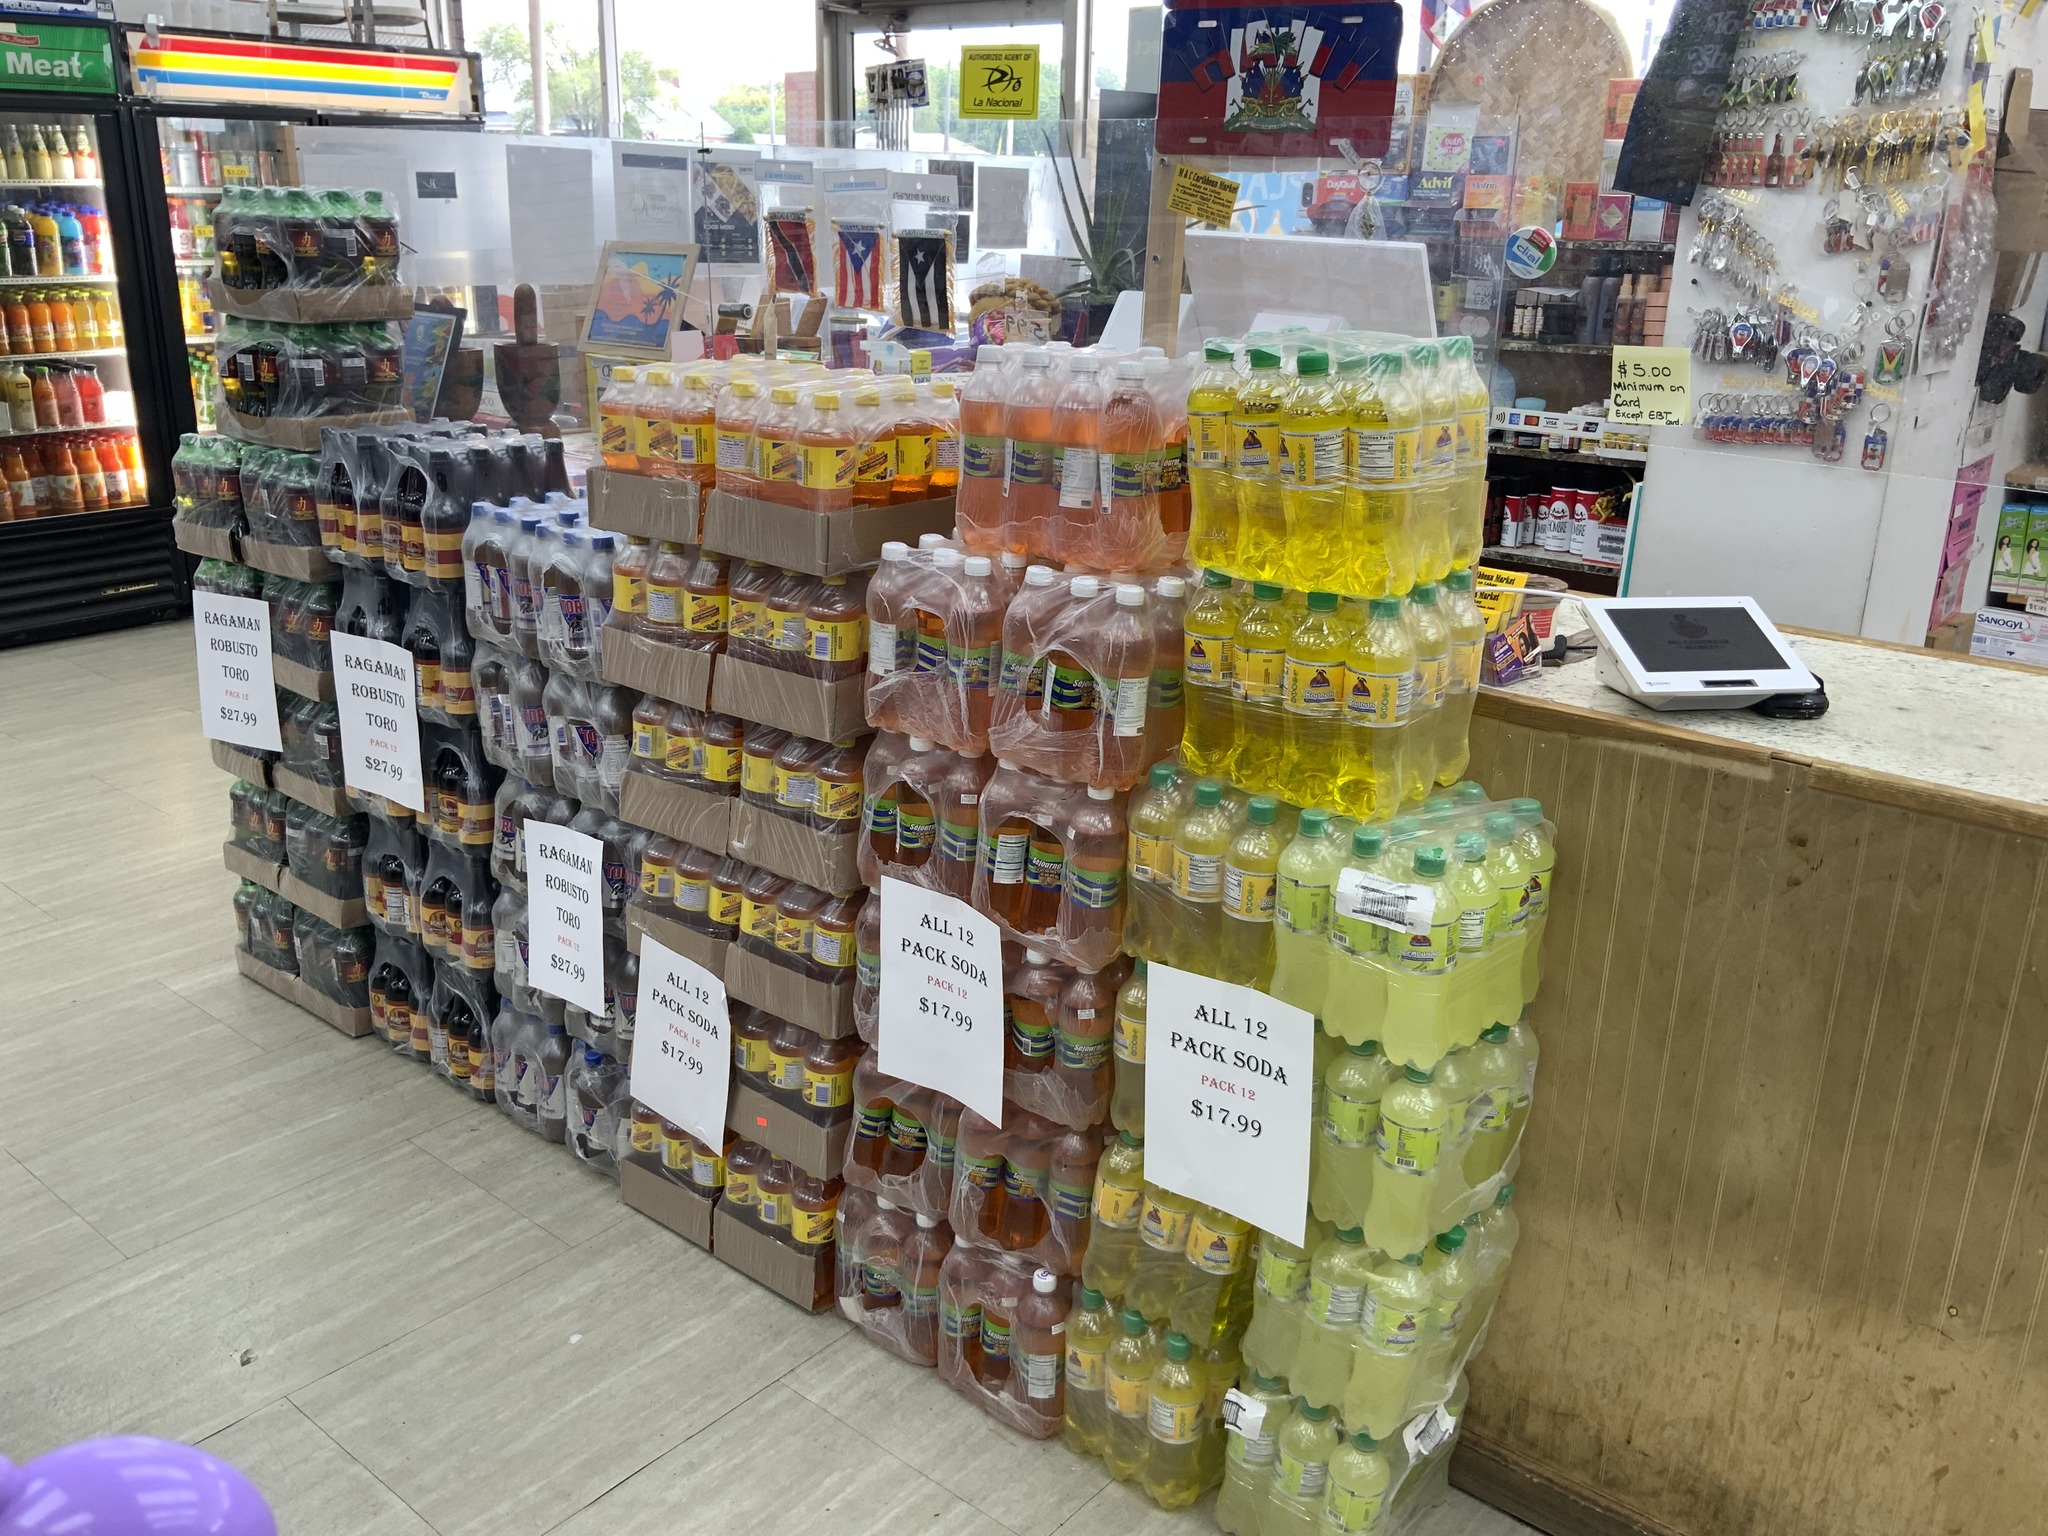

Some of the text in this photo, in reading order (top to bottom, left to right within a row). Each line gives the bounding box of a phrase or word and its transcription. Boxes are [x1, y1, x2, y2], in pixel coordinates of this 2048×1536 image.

[968, 53, 1032, 61] AUTHORIZED AGENT OF
[1178, 8, 1381, 93] HAITI
[5, 51, 82, 78] Meat
[973, 97, 1024, 108] La Nacional
[1418, 176, 1453, 189] Advil
[1471, 180, 1499, 189] Motrin
[1516, 243, 1541, 266] dial
[1613, 381, 1685, 394] Minimum on
[1614, 393, 1640, 408] Card
[1616, 409, 1672, 421] Except EBT
[1549, 521, 1568, 535] OMBRE
[1495, 574, 1516, 586] Market
[560, 600, 582, 614] TOR
[1480, 592, 1500, 602] Market
[204, 610, 261, 632] RAGAMAN
[1977, 613, 2024, 630] SANOGYL
[210, 637, 258, 658] ROBUSTO
[221, 665, 250, 682] TORO
[344, 653, 407, 682] RAGAMAN
[225, 689, 250, 701] PACK 12
[351, 682, 406, 709] ROBUSTO
[220, 706, 257, 727] $27.99
[365, 712, 398, 733] TORO
[521, 708, 545, 722] TOR
[370, 738, 398, 753] PACK 12
[365, 755, 403, 782] $27.99
[539, 843, 593, 876] RAGAMAN
[545, 874, 589, 904] ROBUSTO
[556, 906, 581, 930] TORO
[919, 913, 975, 947] ALL 12
[557, 934, 580, 952] PACK 12
[550, 953, 585, 983] $27.99
[900, 937, 988, 988] PACK SODA
[666, 971, 710, 1005] ALL 12
[927, 974, 968, 1000] PACK 12
[651, 987, 719, 1041] PACK SODA
[919, 996, 973, 1033] $17.99
[1194, 1004, 1268, 1040] ALL 12
[668, 1022, 701, 1049] PACK 12
[661, 1038, 703, 1076] $17.99
[1170, 1031, 1289, 1086] PACK SODA
[1200, 1074, 1257, 1101] PACK 12
[1190, 1098, 1263, 1138] $17.99
